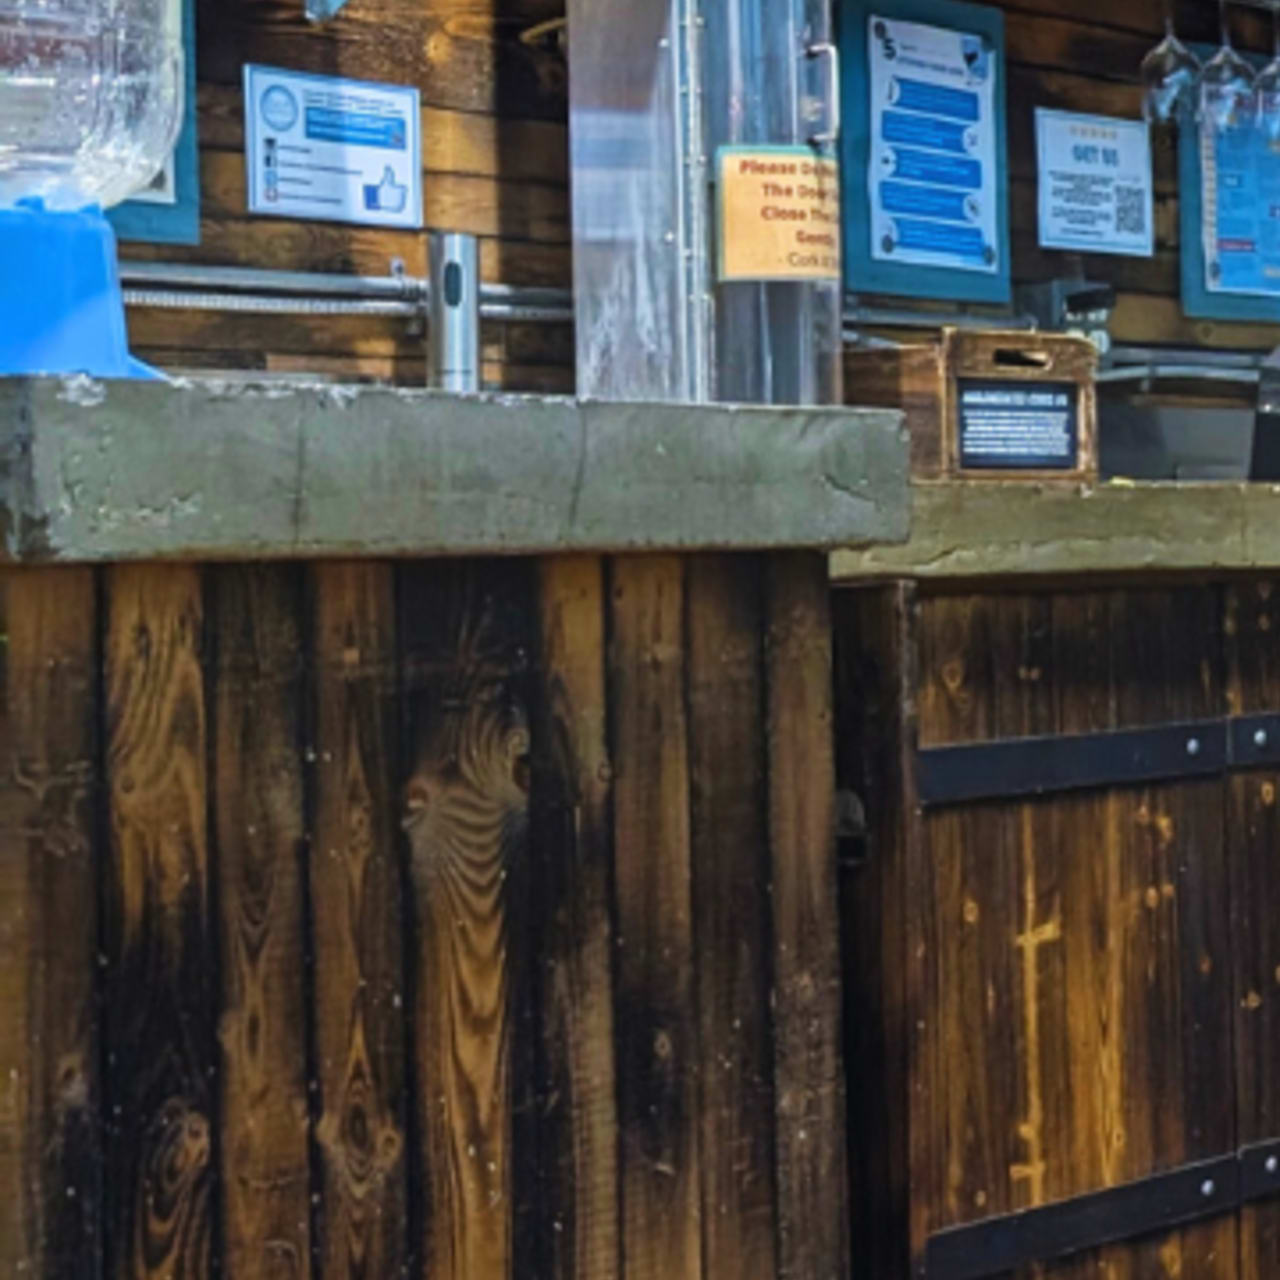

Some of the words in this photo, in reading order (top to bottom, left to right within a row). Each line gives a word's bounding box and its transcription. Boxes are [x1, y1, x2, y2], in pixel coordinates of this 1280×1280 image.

[739, 160, 797, 175] Please
[762, 183, 793, 197] The
[761, 205, 806, 220] Close
